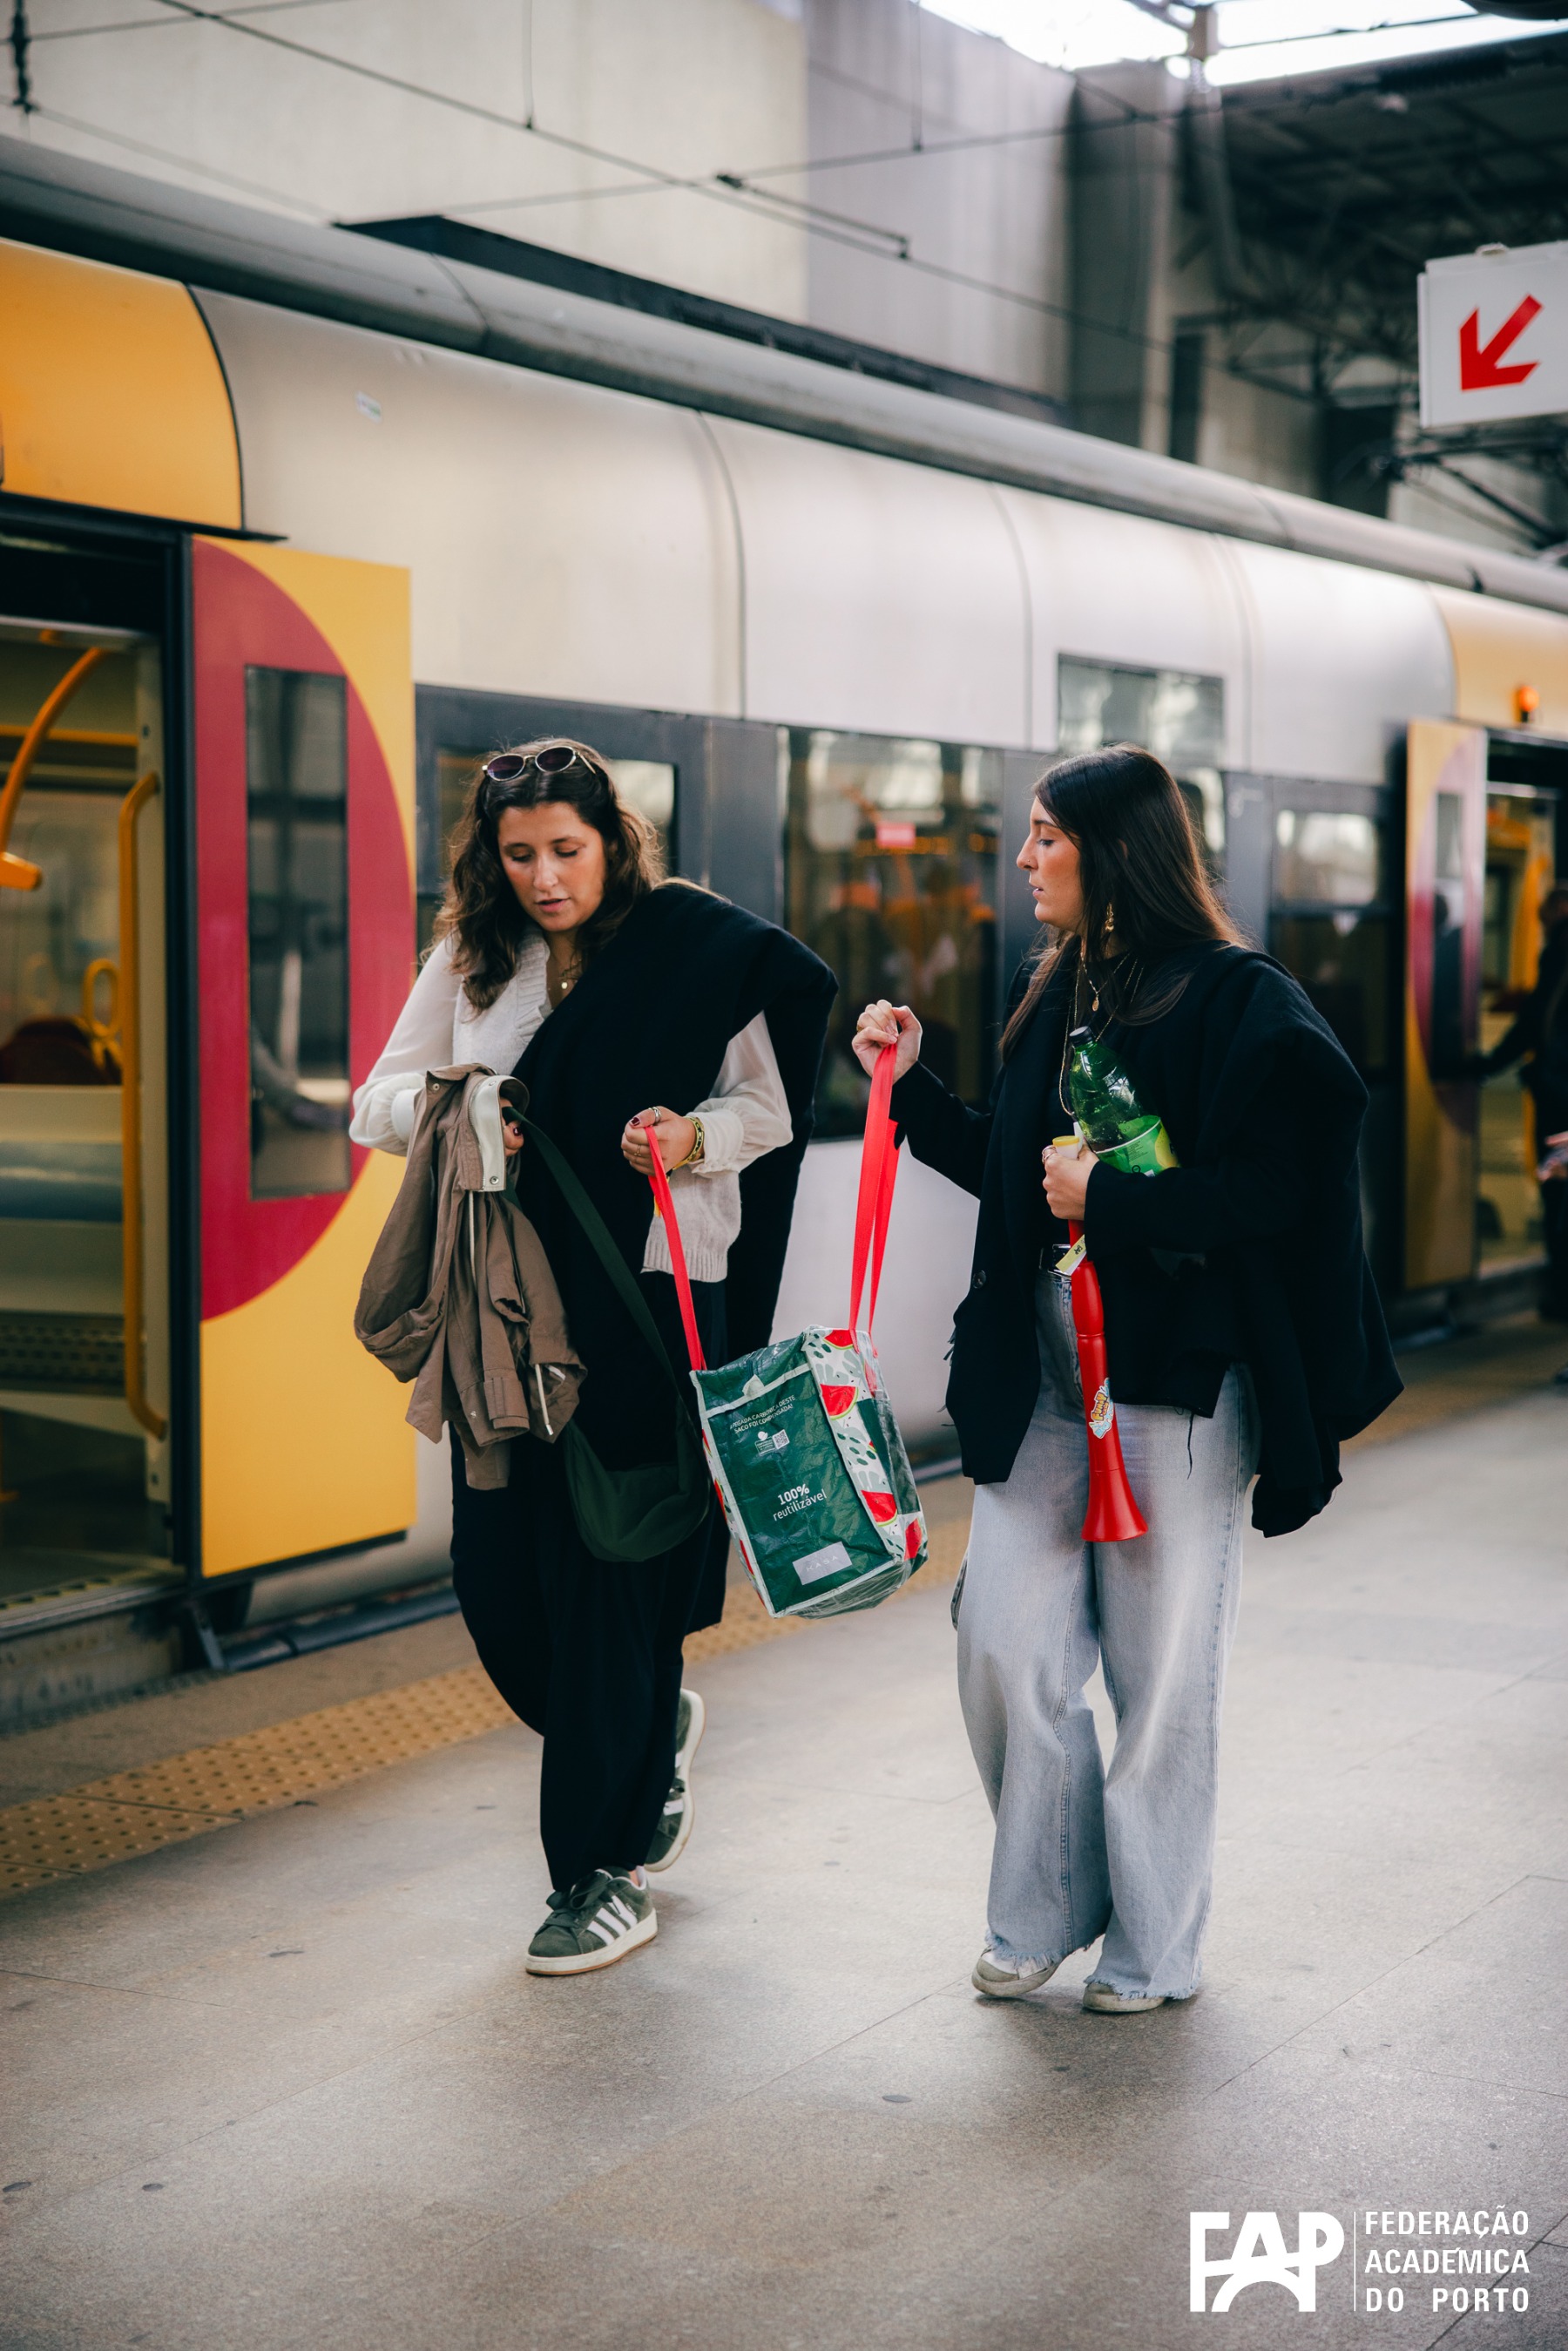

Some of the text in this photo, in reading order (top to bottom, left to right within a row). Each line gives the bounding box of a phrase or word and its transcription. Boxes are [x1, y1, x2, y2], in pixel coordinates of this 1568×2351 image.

[733, 1417, 752, 1427] PEGADA
[779, 1395, 796, 1406] DESTE
[734, 1424, 749, 1433] SACO
[759, 1403, 794, 1425] COMPENSADA!
[1091, 1390, 1108, 1421] FUNNY
[773, 1488, 827, 1521] reutilizável
[777, 1483, 810, 1505] 100%
[806, 1555, 838, 1572] KASA
